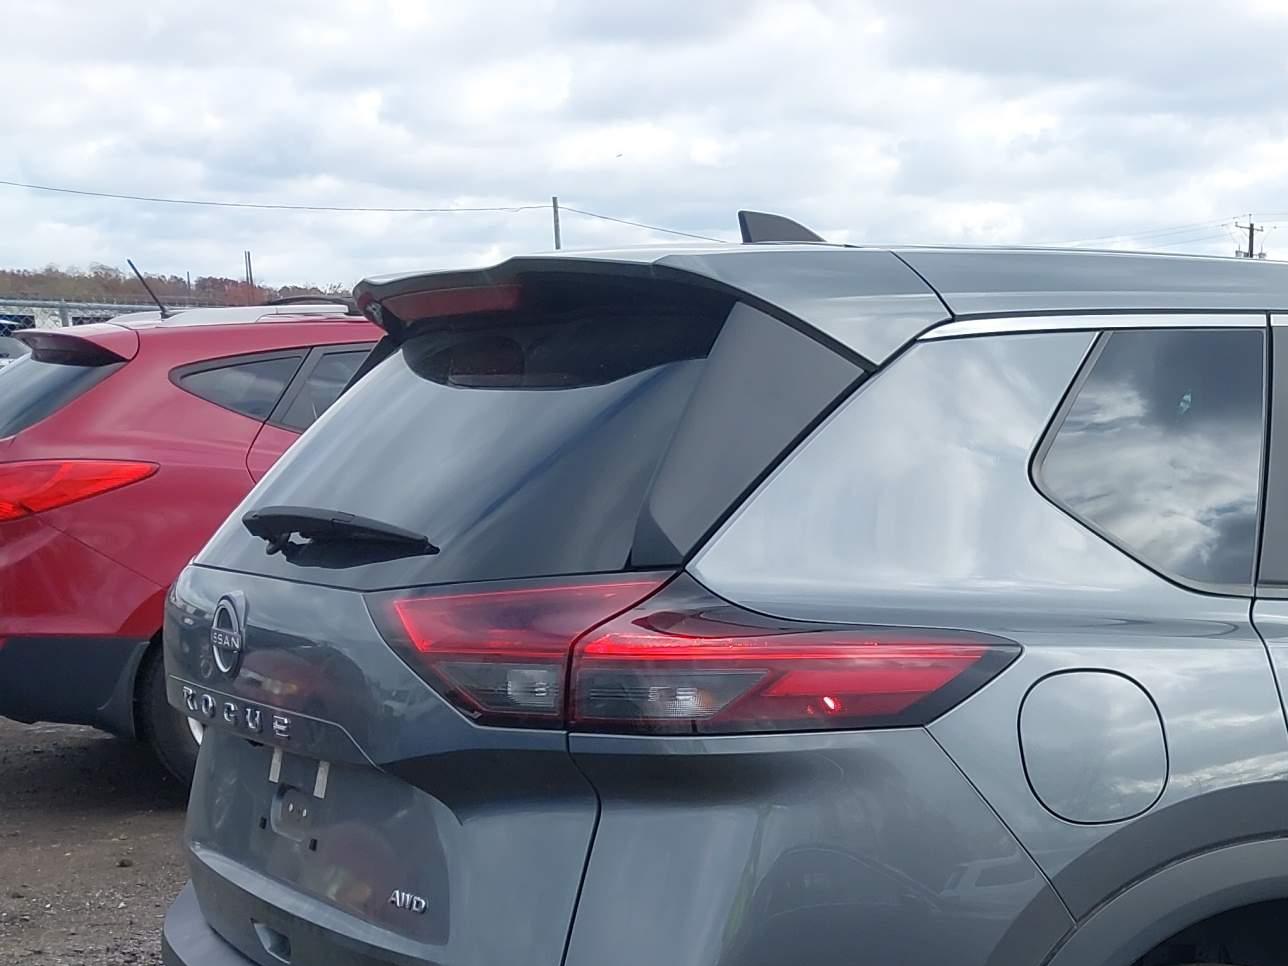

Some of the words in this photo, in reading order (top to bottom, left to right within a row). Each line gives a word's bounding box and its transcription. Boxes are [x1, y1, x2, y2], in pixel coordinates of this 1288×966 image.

[212, 631, 241, 650] SSAN
[182, 686, 291, 737] ROGUE
[387, 889, 427, 912] AWD
